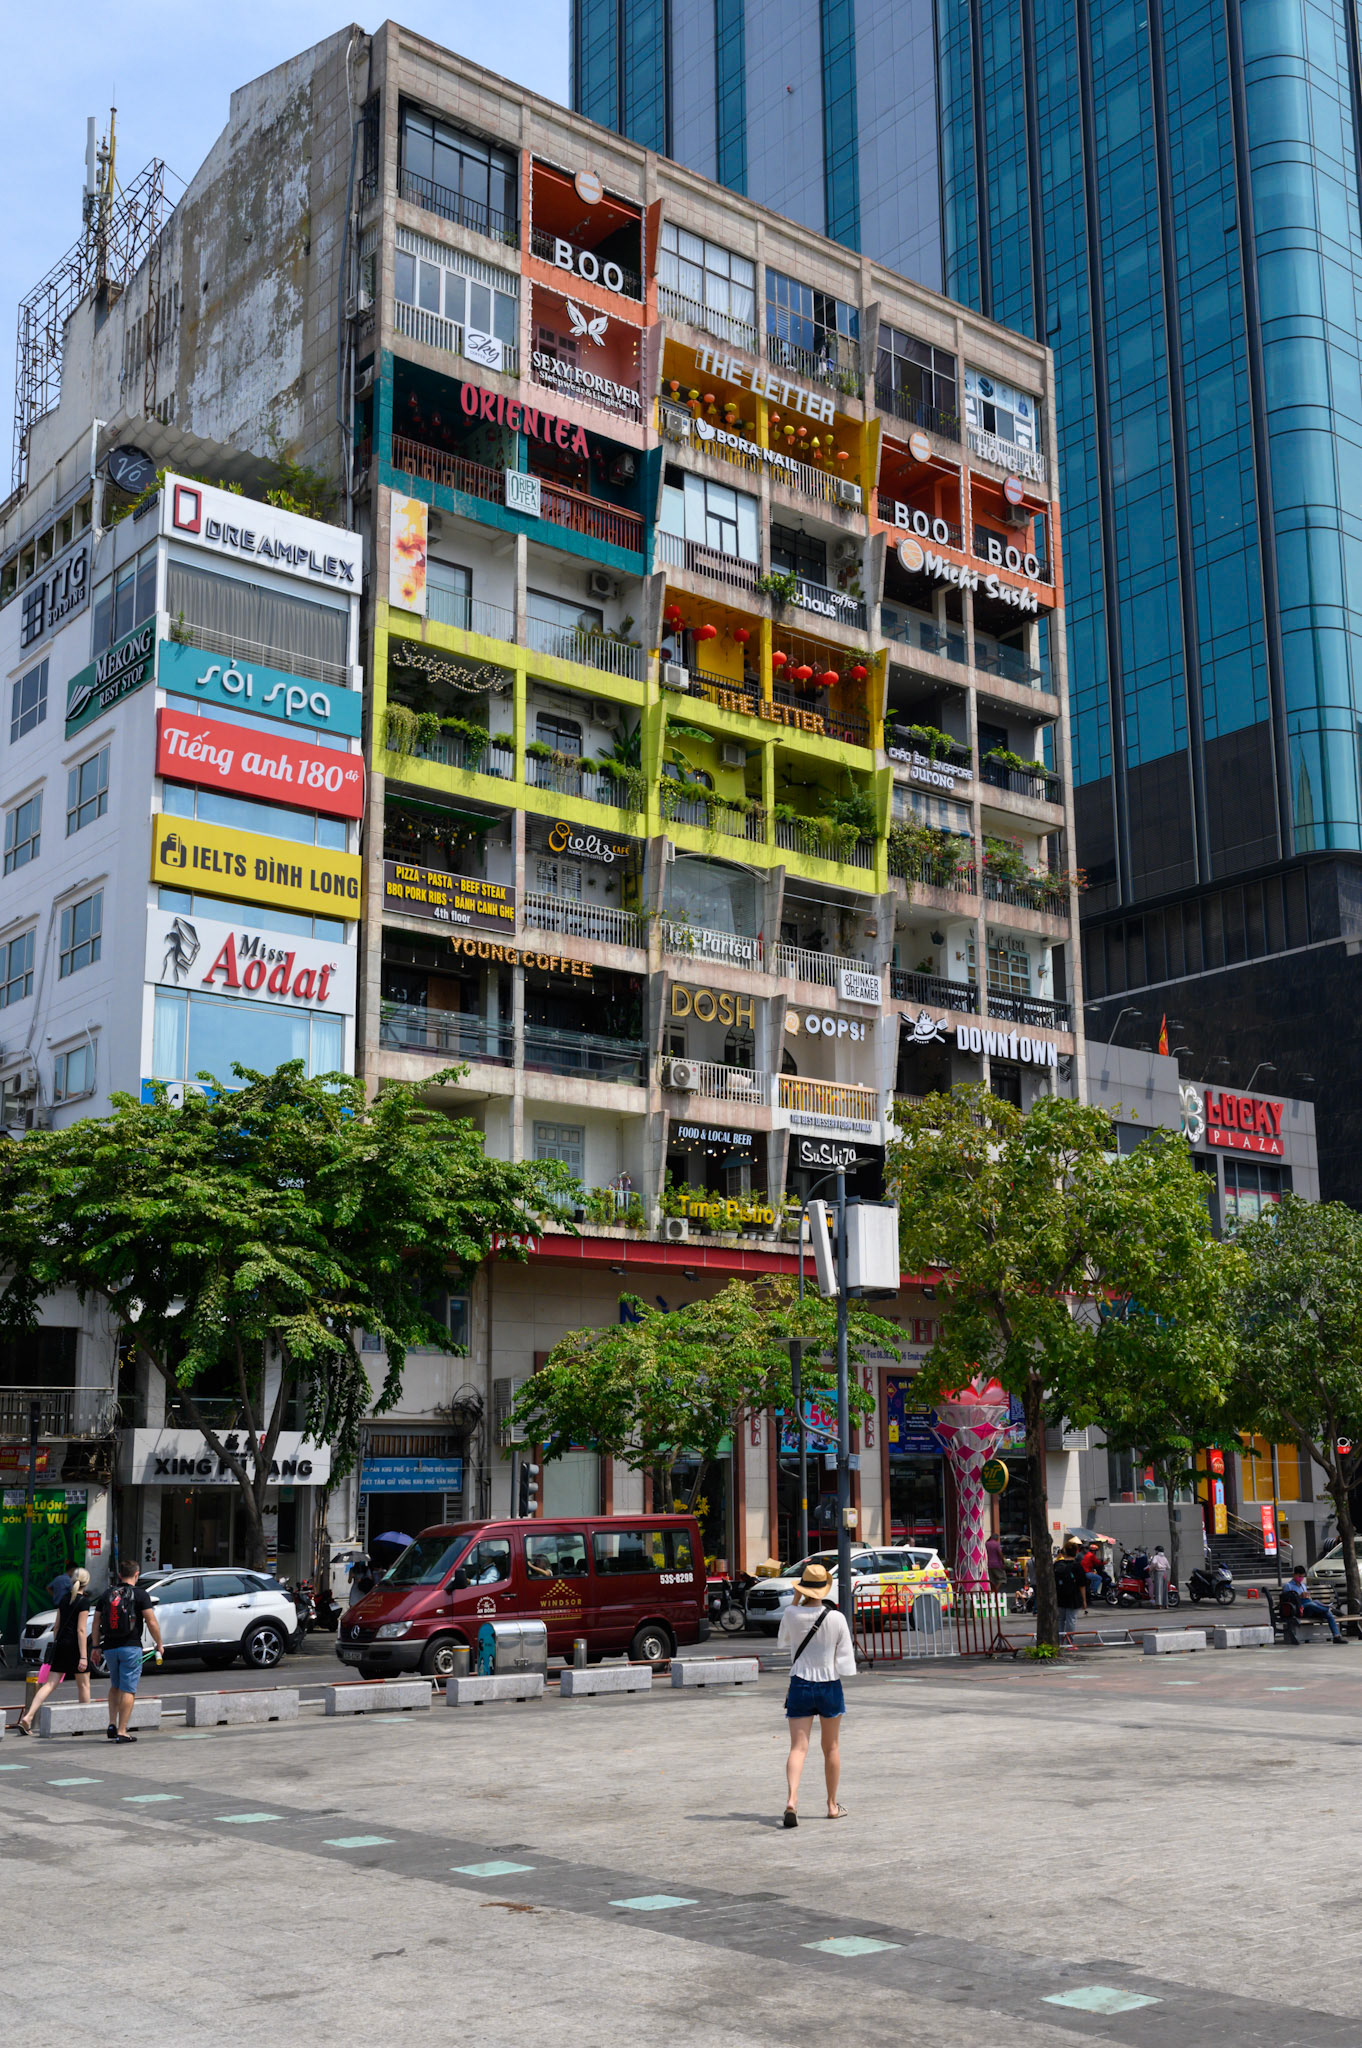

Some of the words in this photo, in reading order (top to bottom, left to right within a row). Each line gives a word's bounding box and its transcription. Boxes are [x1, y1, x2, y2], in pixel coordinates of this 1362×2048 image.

[555, 238, 624, 292] BOO
[468, 334, 500, 363] Sky
[533, 351, 573, 379] SEXY
[575, 367, 643, 408] FOREVER
[699, 344, 745, 387] THE
[750, 367, 836, 426] LETTER
[461, 383, 590, 459] ORIENTEA
[717, 429, 760, 458] BORA
[763, 448, 799, 473] NAIL
[895, 501, 949, 545] BOO
[206, 517, 355, 581] DREAMPLEX
[988, 537, 1040, 579] BOO
[46, 548, 86, 609] TTG
[925, 550, 978, 591] Michi
[985, 574, 1038, 613] Sushi
[830, 594, 858, 610] coffee
[94, 627, 152, 687] MEKONG
[100, 682, 120, 708] REST
[121, 662, 145, 692] STOP
[264, 683, 331, 717] spa
[717, 688, 755, 716] THE
[759, 698, 827, 737] LETTER
[163, 727, 235, 776] Tiếng
[241, 750, 293, 783] anh
[297, 759, 344, 793] 180
[931, 760, 974, 780] SINGAPORE
[193, 845, 247, 877] IELTS
[254, 857, 303, 888] ĐÌNH
[310, 869, 359, 899] LONG
[395, 865, 420, 883] PIZZA
[427, 872, 453, 889] PASTA
[460, 879, 480, 894] BEEF
[481, 883, 506, 900] STEAK
[386, 881, 403, 899] BBQ
[404, 885, 427, 902] PORK
[428, 890, 447, 906] RIBS
[454, 894, 475, 912] BÁNH
[477, 900, 498, 916] CANH
[499, 904, 515, 922] GHẸ
[433, 907, 449, 920] 4th
[450, 910, 471, 924] floor
[202, 931, 332, 1001] Aodai
[239, 933, 286, 963] Miss
[451, 936, 518, 965] YOUNG
[522, 950, 593, 978] COFFEE
[846, 985, 879, 1001] DREAMER
[849, 973, 879, 990] THINKER
[672, 984, 755, 1030] DOSH
[805, 1014, 865, 1041] OOPS!
[791, 1114, 801, 1124] THE
[801, 1115, 815, 1127] BEST
[815, 1117, 838, 1129] DESSERT
[1204, 1090, 1284, 1136] LUCKY
[678, 1126, 700, 1139] FOOD
[707, 1130, 732, 1143] LOCAL
[732, 1133, 752, 1146] BEER
[1213, 1129, 1279, 1154] PLAZA
[678, 1195, 720, 1218] Time
[726, 1200, 775, 1225] Bistro
[155, 1458, 212, 1476] XING
[47, 1513, 68, 1524] VUI
[660, 1572, 694, 1584] 53S-8298
[540, 1599, 582, 1607] WINDSOR
